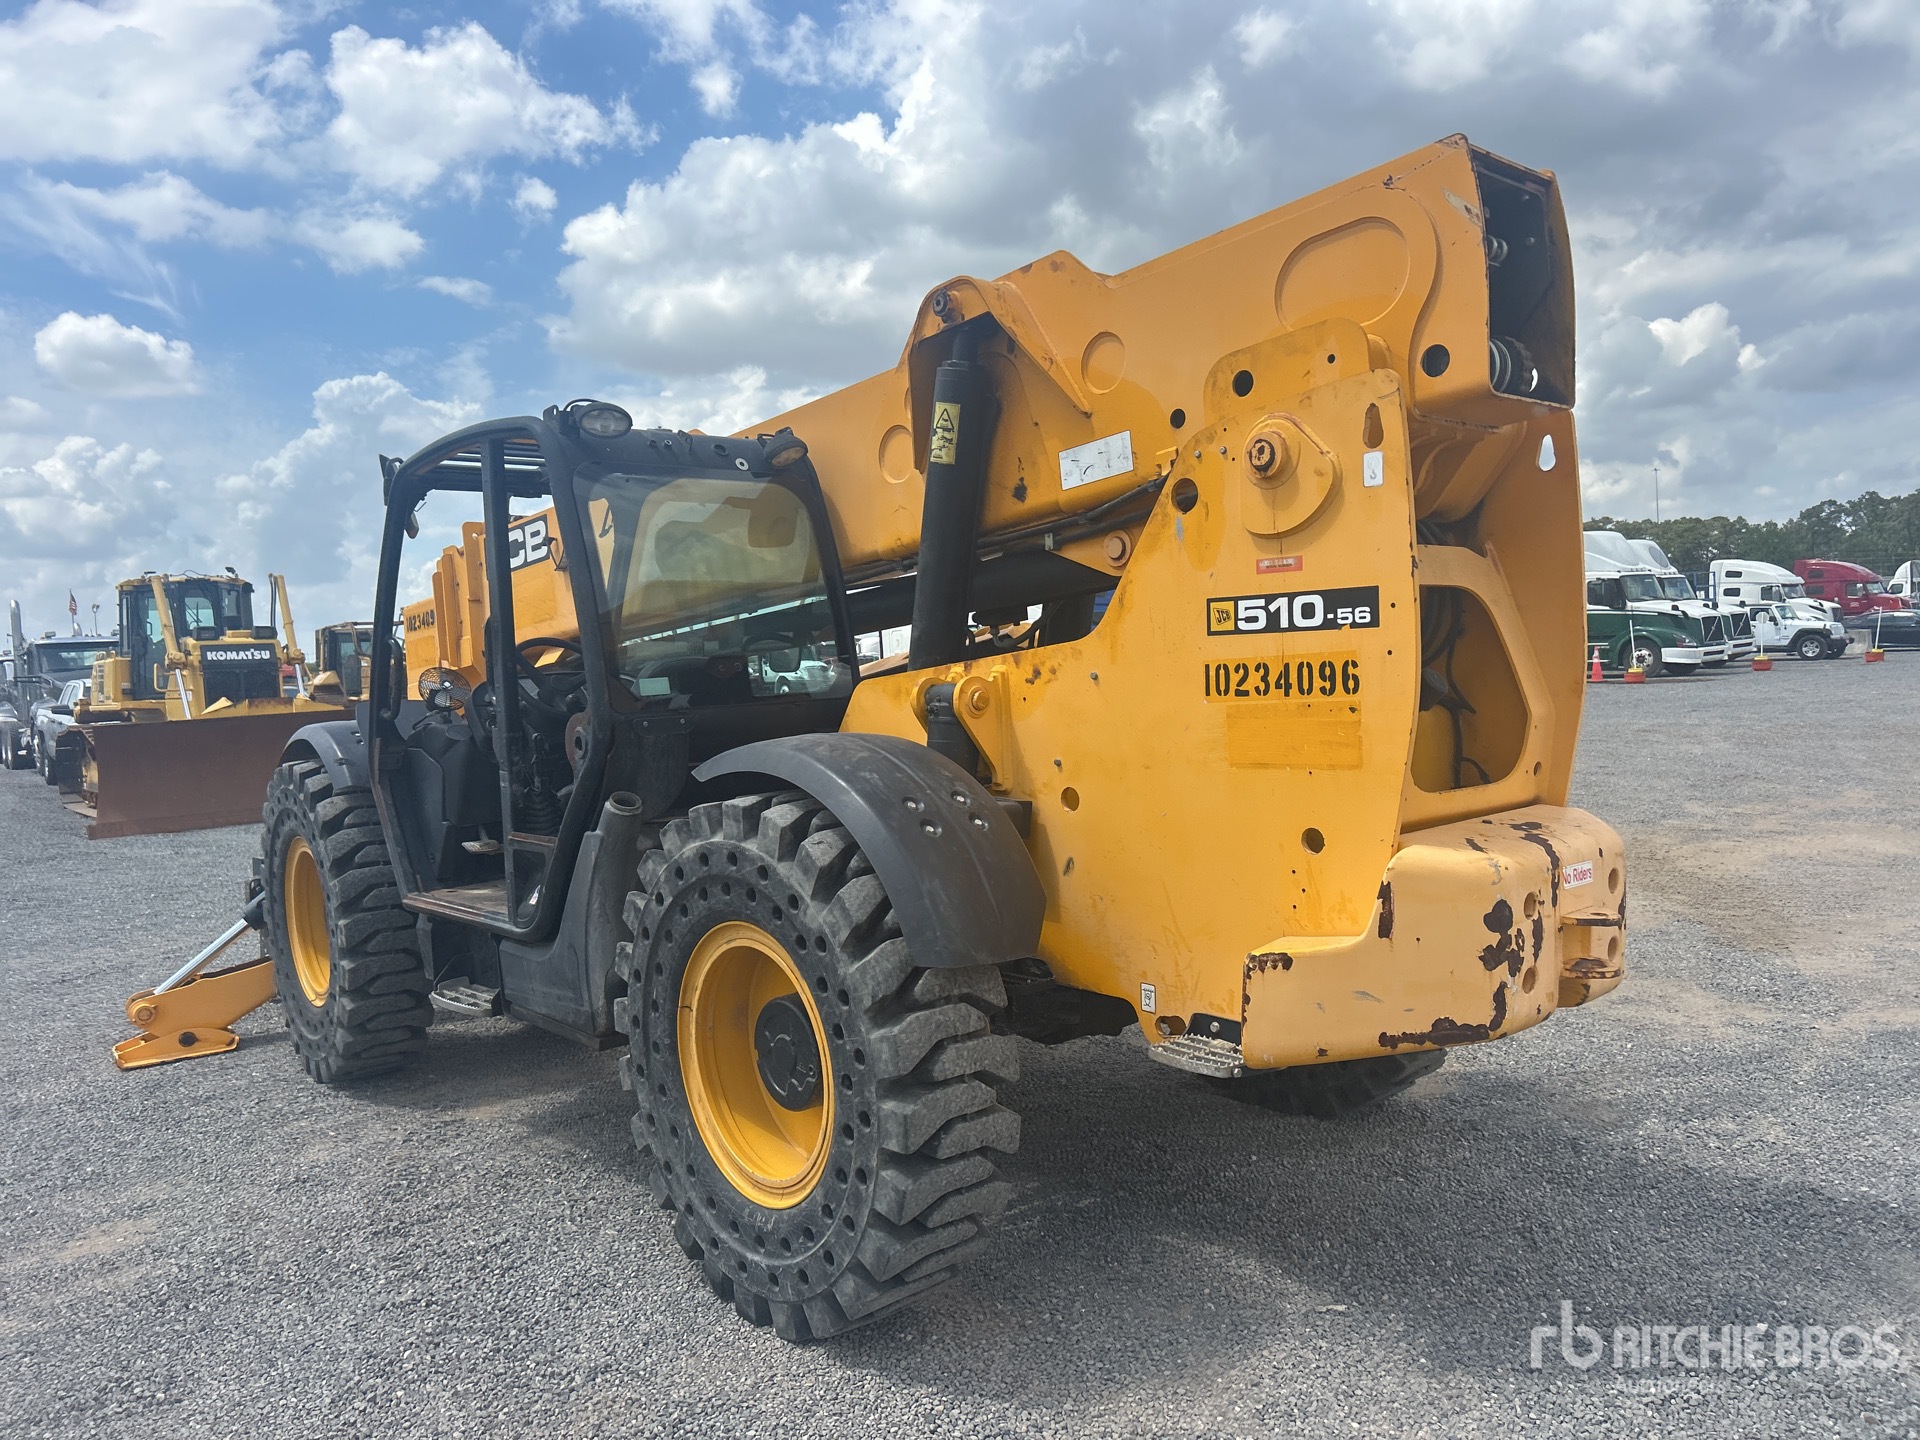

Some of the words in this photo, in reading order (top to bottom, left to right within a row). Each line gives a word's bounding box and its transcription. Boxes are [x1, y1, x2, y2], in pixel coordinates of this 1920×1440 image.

[508, 520, 549, 568] CB
[1213, 607, 1232, 625] JCB
[1237, 594, 1371, 631] 510-56
[206, 648, 271, 660] KOMATSU
[1204, 659, 1360, 698] 10234096
[1572, 866, 1592, 883] Riders
